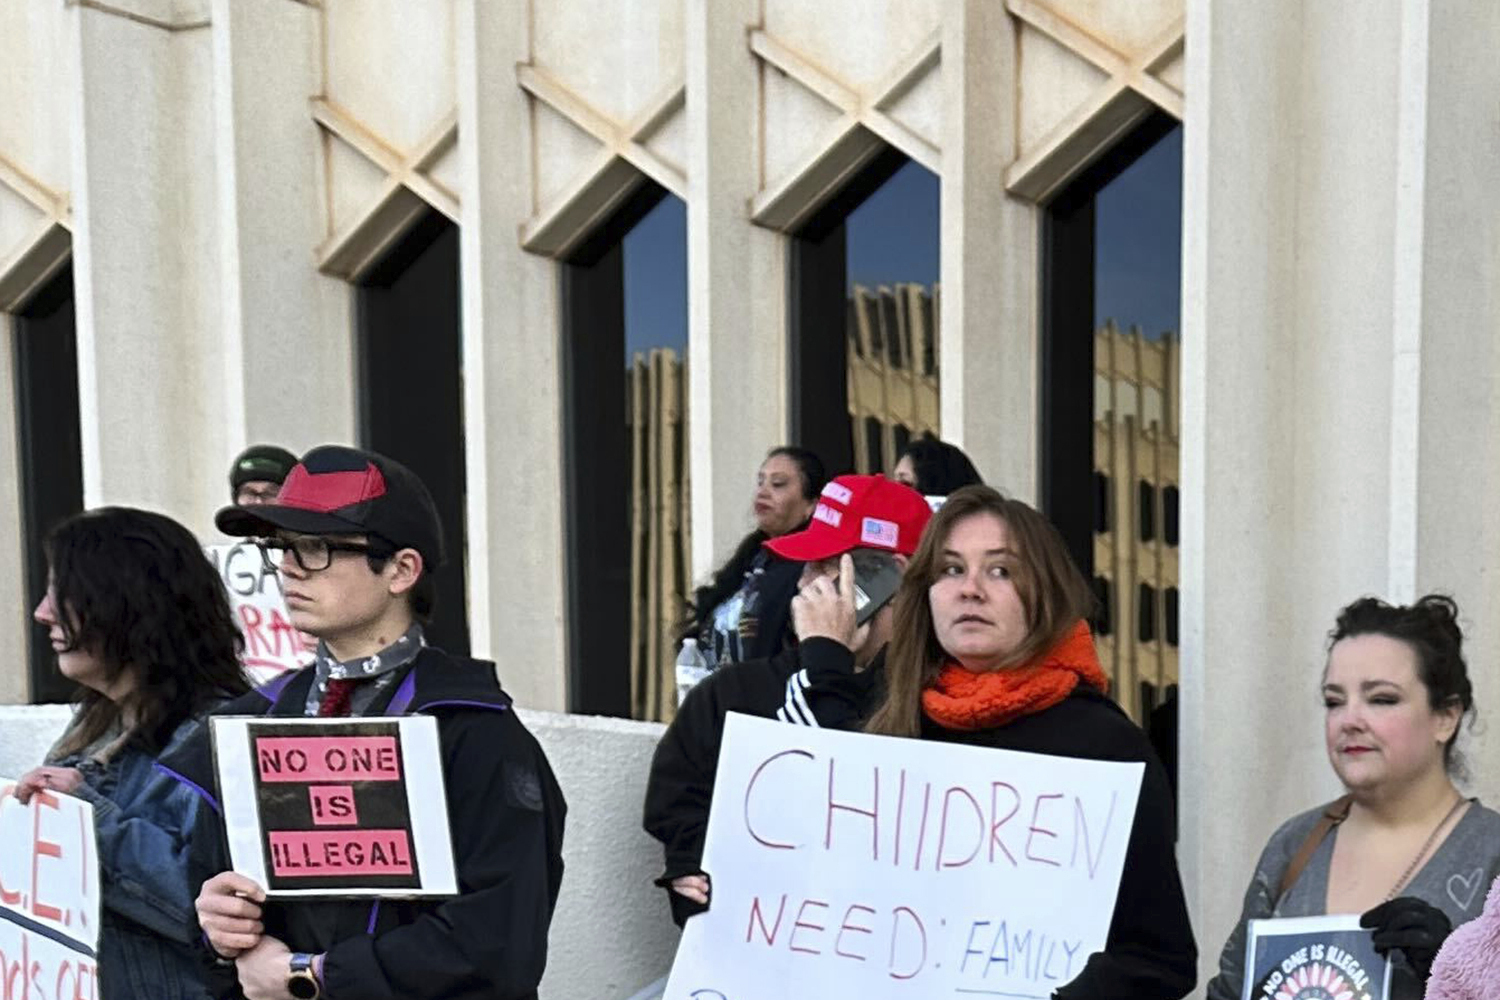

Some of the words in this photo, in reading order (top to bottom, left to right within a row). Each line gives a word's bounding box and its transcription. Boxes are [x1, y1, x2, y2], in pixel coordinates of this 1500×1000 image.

[261, 749, 308, 774] NO
[325, 748, 395, 773] ONE
[314, 795, 352, 818] IS
[273, 841, 408, 869] ILLEGAL
[746, 894, 947, 980] NEED:
[960, 919, 1083, 982] FAMILY
[1263, 970, 1283, 995] NO
[1281, 946, 1309, 974] ONE
[1310, 943, 1325, 961] IS
[1326, 945, 1370, 991] ILLEGAL
